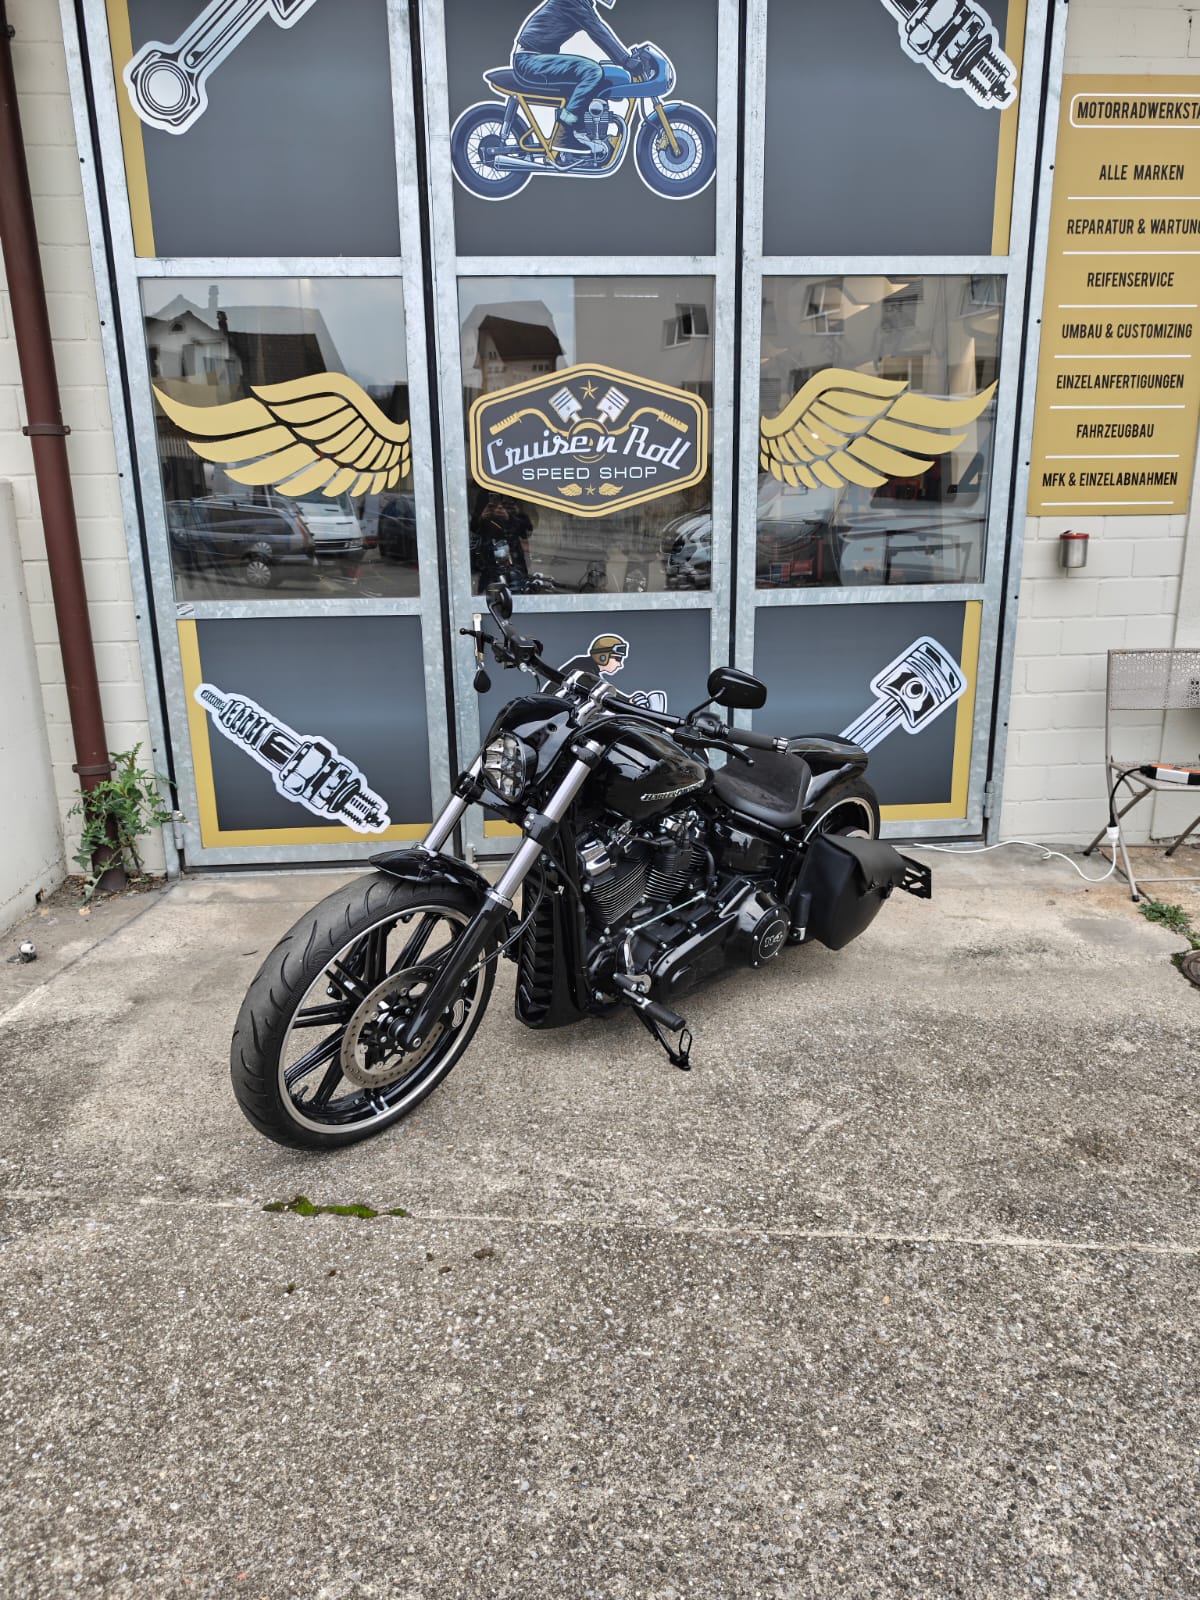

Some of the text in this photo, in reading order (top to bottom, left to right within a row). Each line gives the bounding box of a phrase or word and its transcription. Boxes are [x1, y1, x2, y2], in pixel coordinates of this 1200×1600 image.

[1098, 164, 1185, 181] ALLE MARKEN
[1066, 218, 1134, 235] REPARATUR
[1137, 218, 1146, 235] &
[1086, 271, 1175, 288] REIFENSERVICE
[1061, 322, 1193, 339] UMBAU & CUSTOMIZING
[1056, 374, 1185, 390] EINZELANFERTIGUNGEN
[1076, 423, 1155, 439] FAHRZEUGBAU
[486, 430, 592, 476] Cruise
[622, 423, 692, 471] Roll
[521, 466, 658, 481] SPEED SHOP
[1042, 471, 1178, 488] MFK & EINZELABNAHMEN
